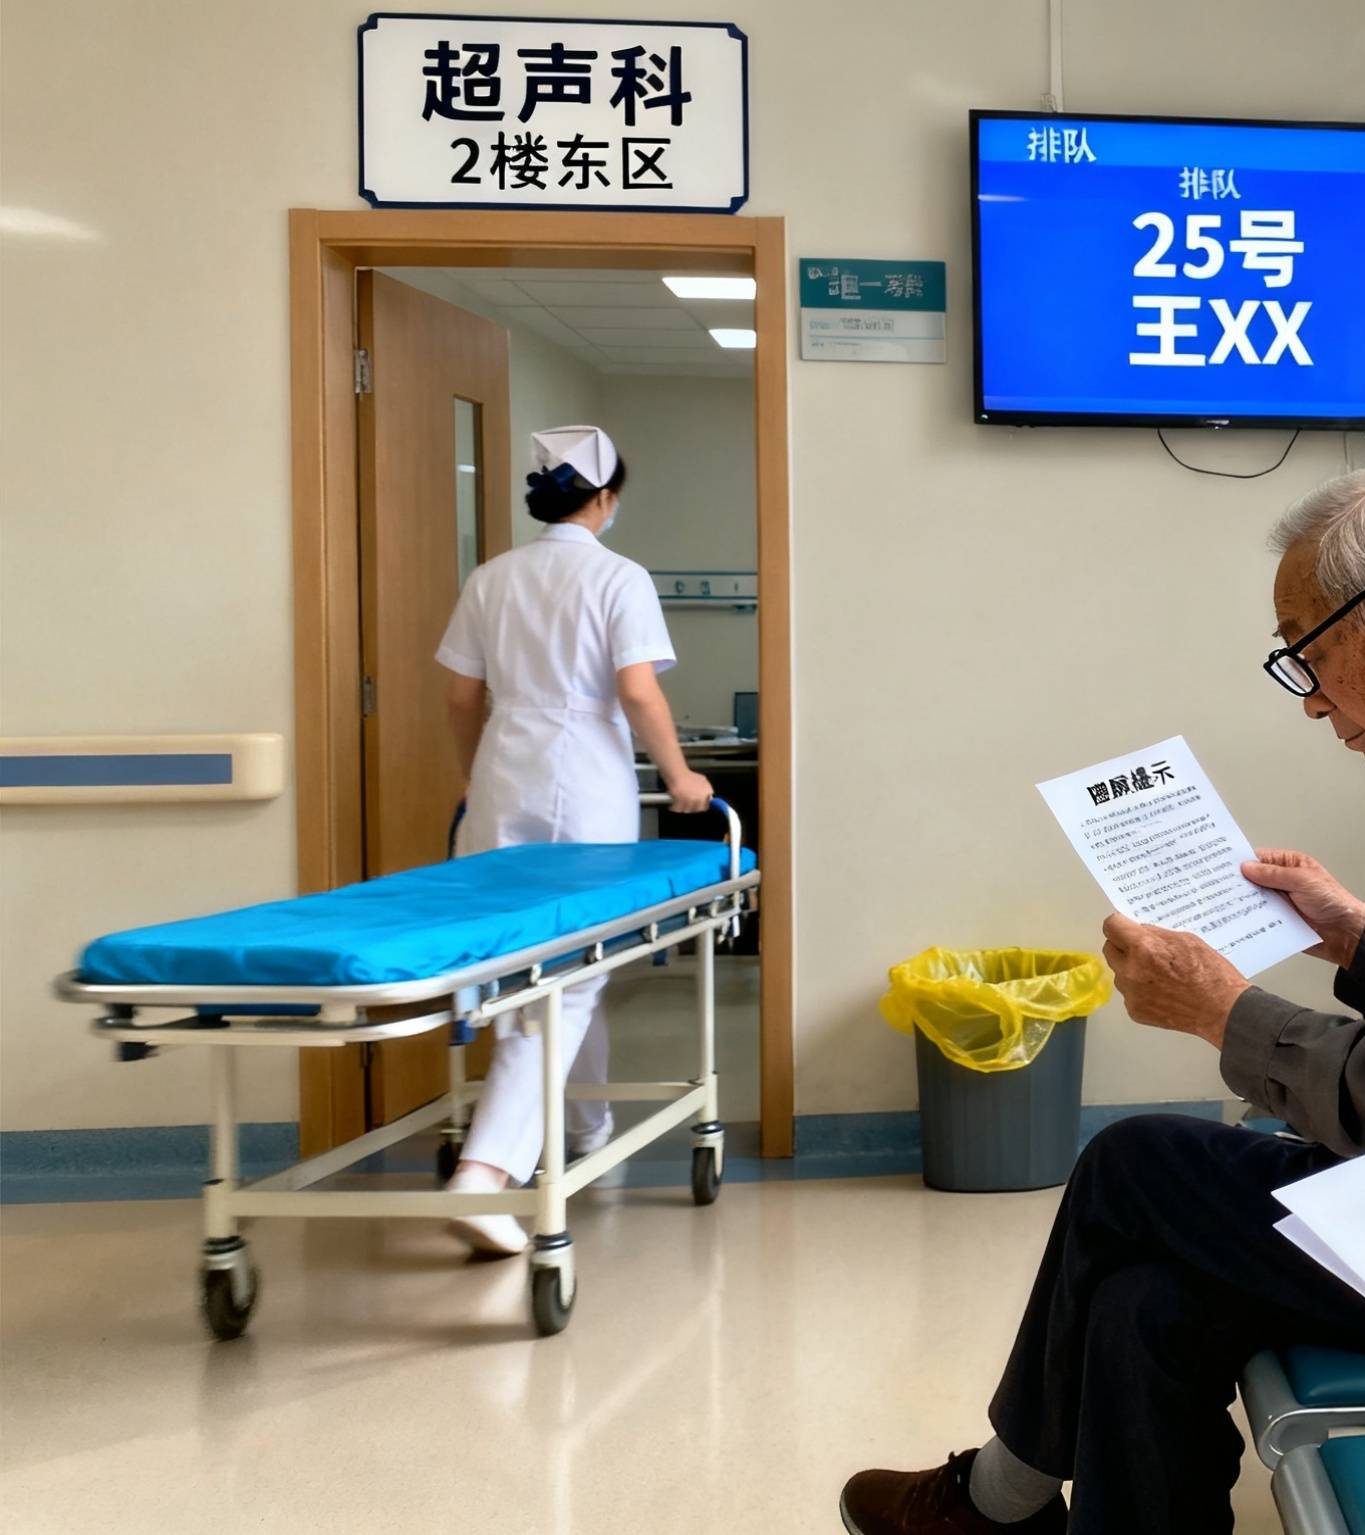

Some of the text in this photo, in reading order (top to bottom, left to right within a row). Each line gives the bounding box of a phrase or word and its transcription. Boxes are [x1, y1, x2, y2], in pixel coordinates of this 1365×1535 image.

[421, 40, 693, 127] 超声科
[449, 130, 675, 191] 2楼东区
[1027, 127, 1097, 164] 排队
[1178, 166, 1242, 200] 排队
[1132, 210, 1305, 288] 25号
[1129, 295, 1315, 367] 王XX
